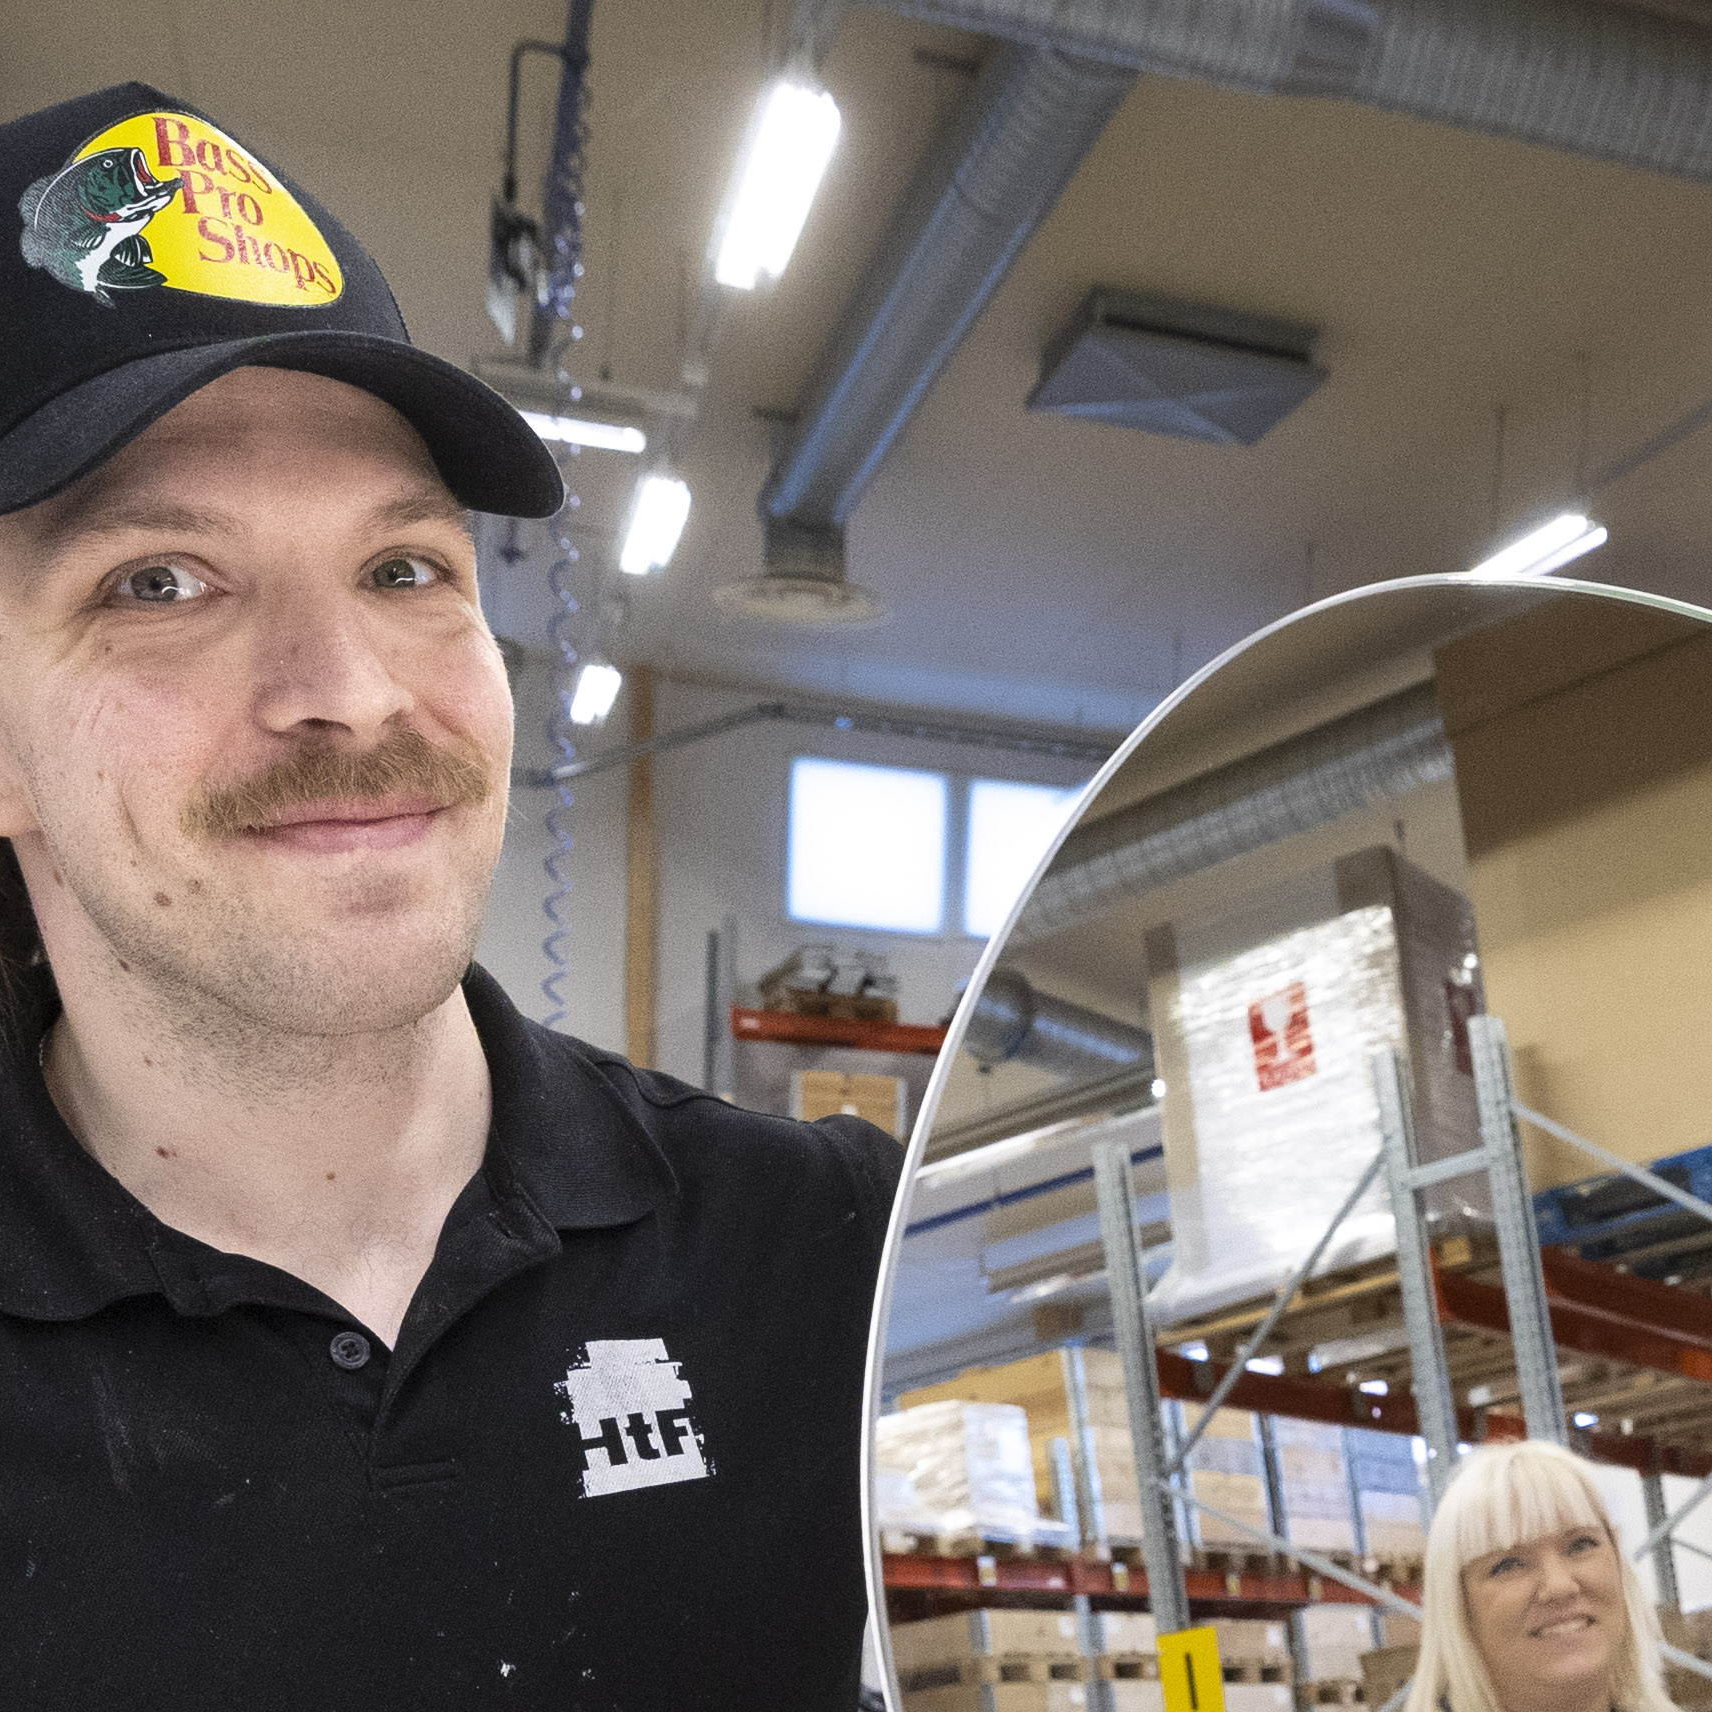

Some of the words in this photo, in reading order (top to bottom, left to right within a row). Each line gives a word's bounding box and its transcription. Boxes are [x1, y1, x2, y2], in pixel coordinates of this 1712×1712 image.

[152, 116, 273, 195] Bass
[176, 169, 264, 227] Pro
[197, 215, 337, 295] Shops
